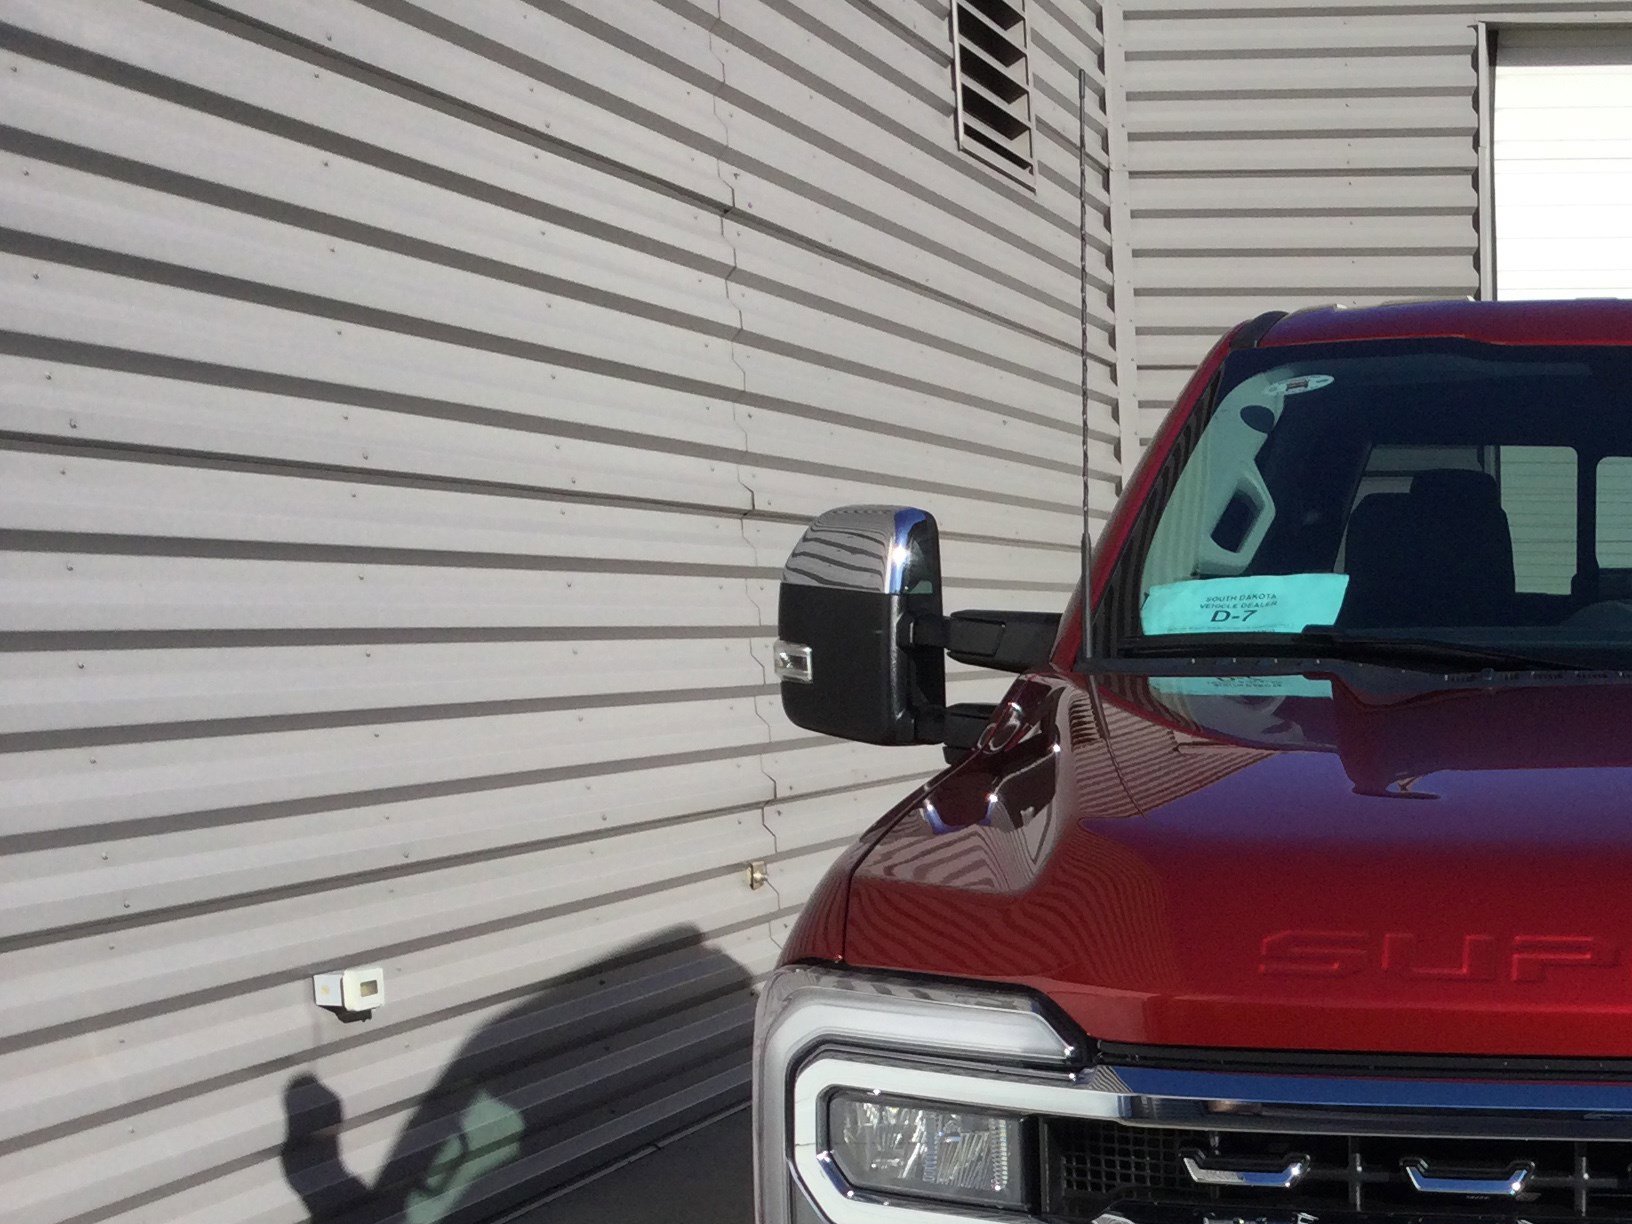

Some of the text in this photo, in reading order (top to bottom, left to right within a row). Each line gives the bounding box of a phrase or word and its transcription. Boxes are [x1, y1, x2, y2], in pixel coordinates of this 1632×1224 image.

[1205, 592, 1277, 602] SOUTH DAKOTA
[1199, 600, 1278, 610] VEHICLE DEALER
[1210, 609, 1259, 623] D-7
